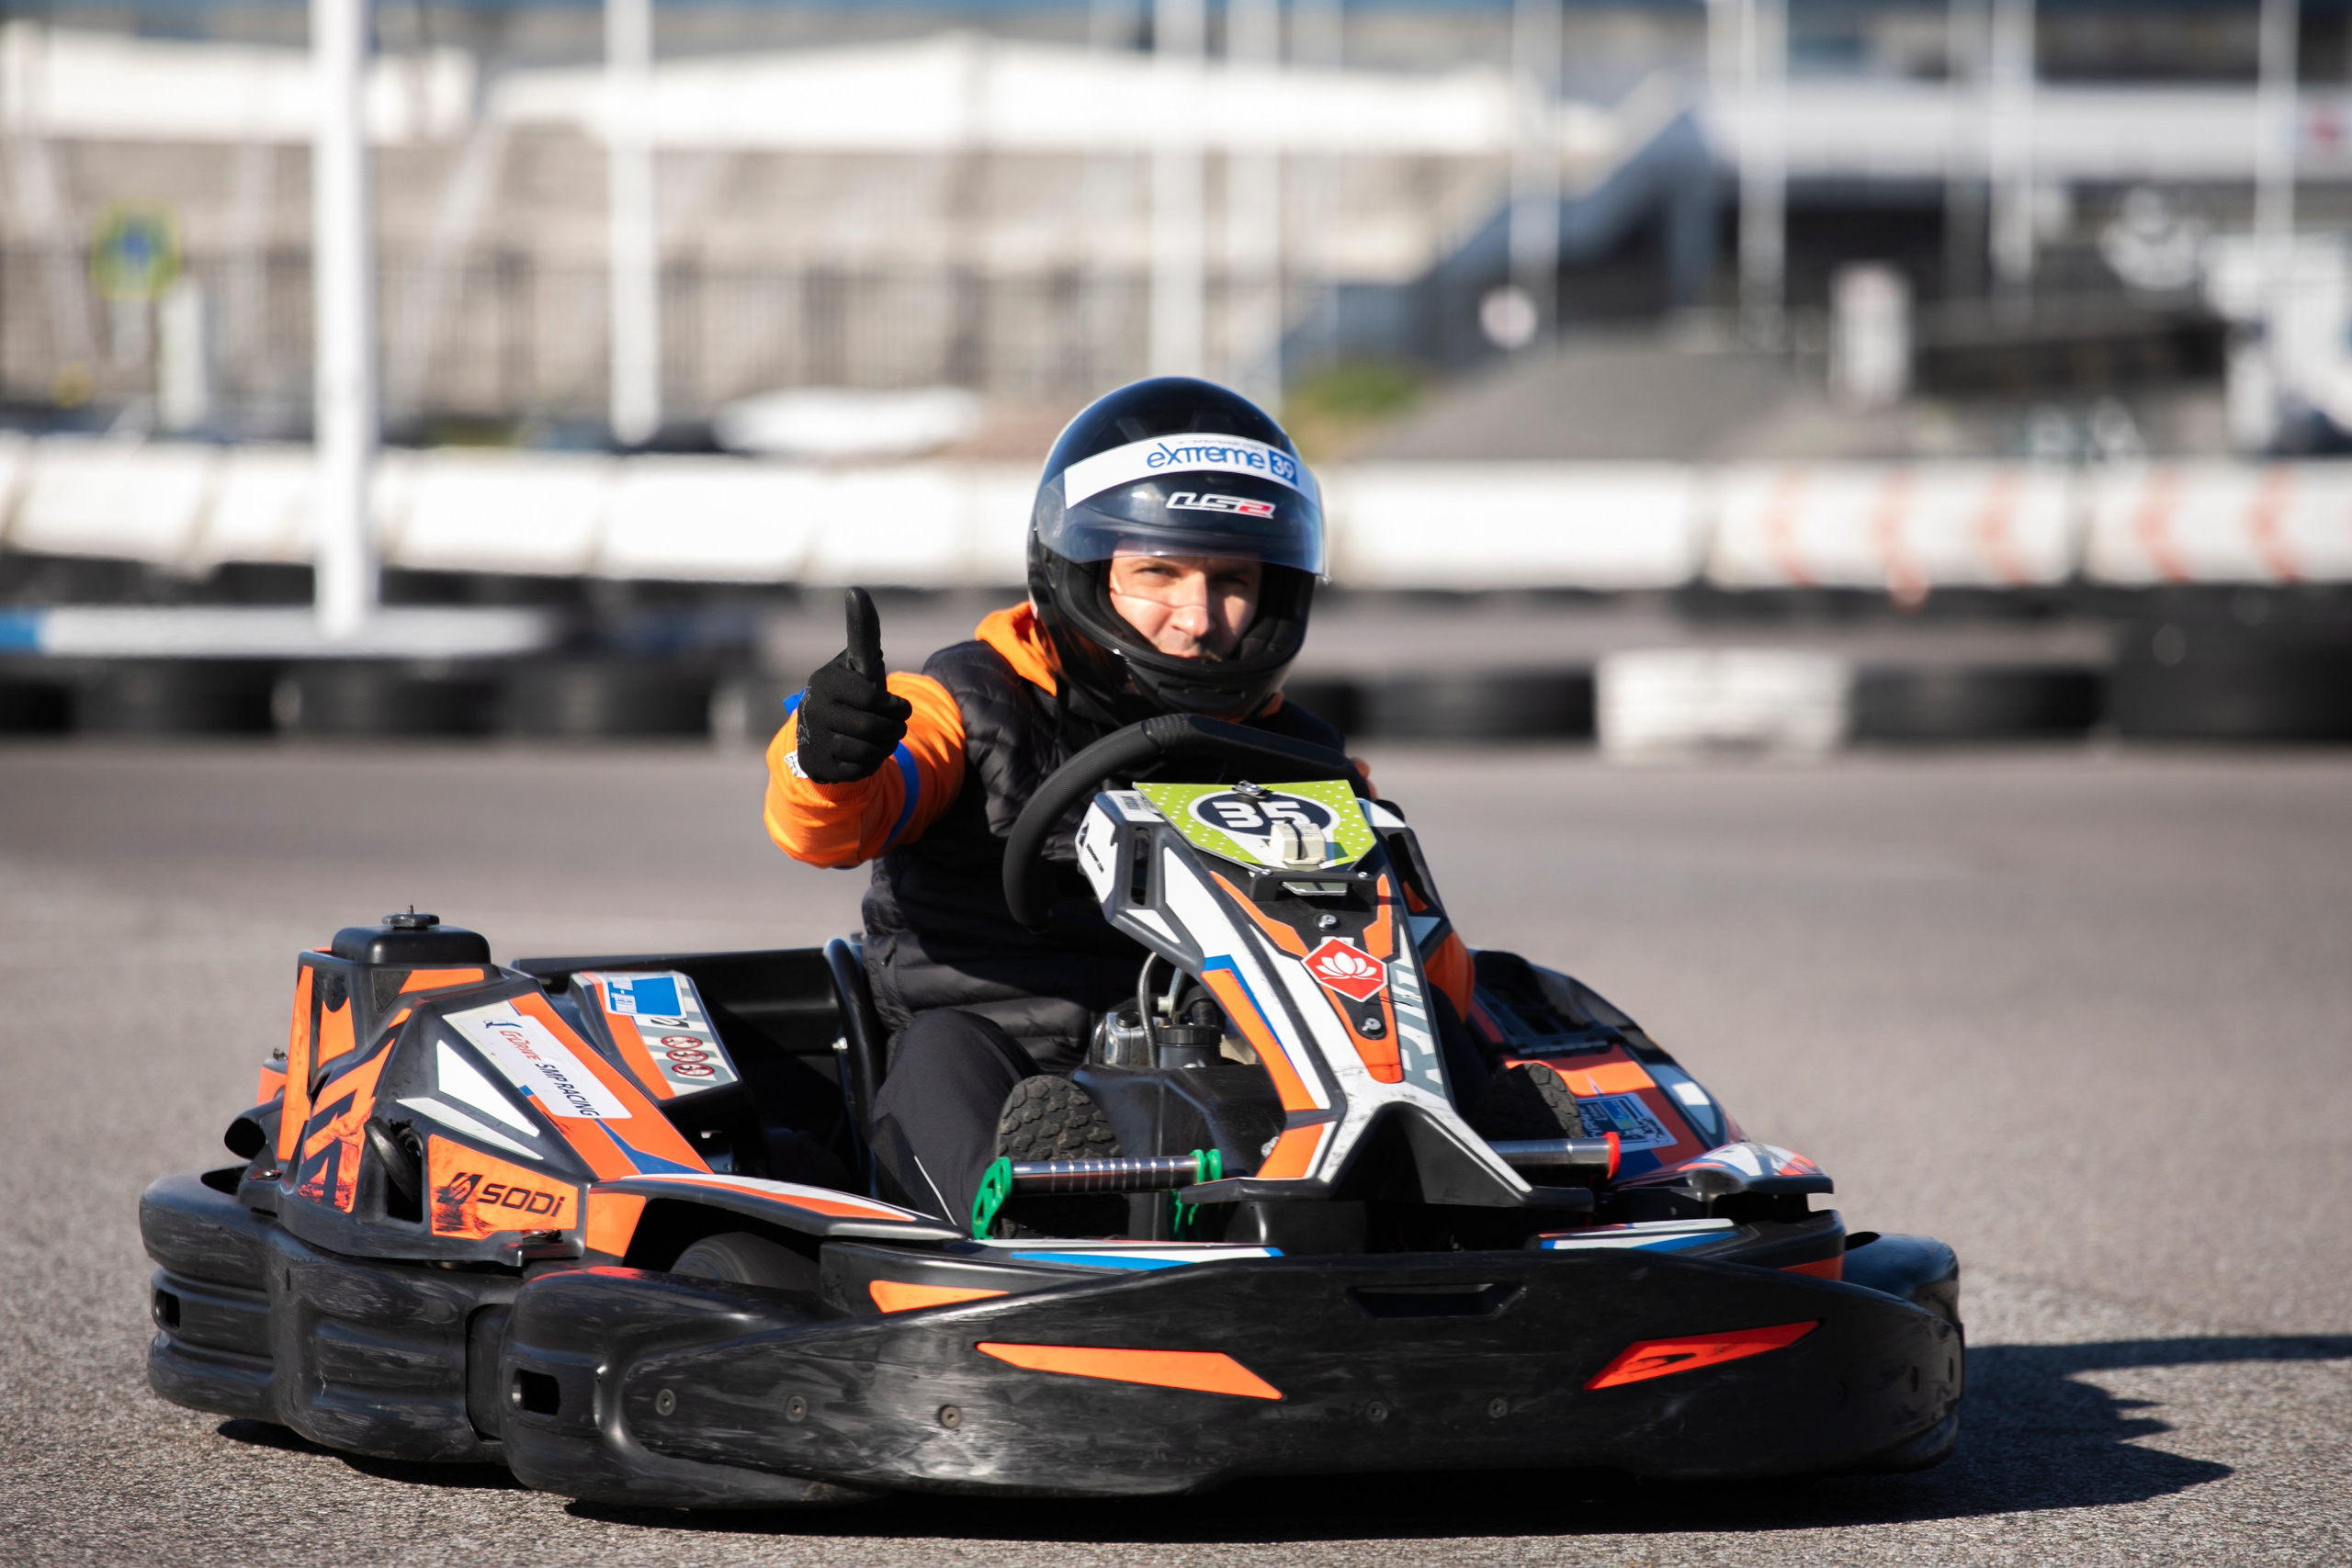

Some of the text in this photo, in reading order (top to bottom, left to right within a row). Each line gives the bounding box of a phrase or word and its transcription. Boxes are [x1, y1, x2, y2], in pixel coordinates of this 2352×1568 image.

[1165, 491, 1276, 520] LS2
[1211, 801, 1311, 828] 35
[554, 1081, 600, 1117] RACING
